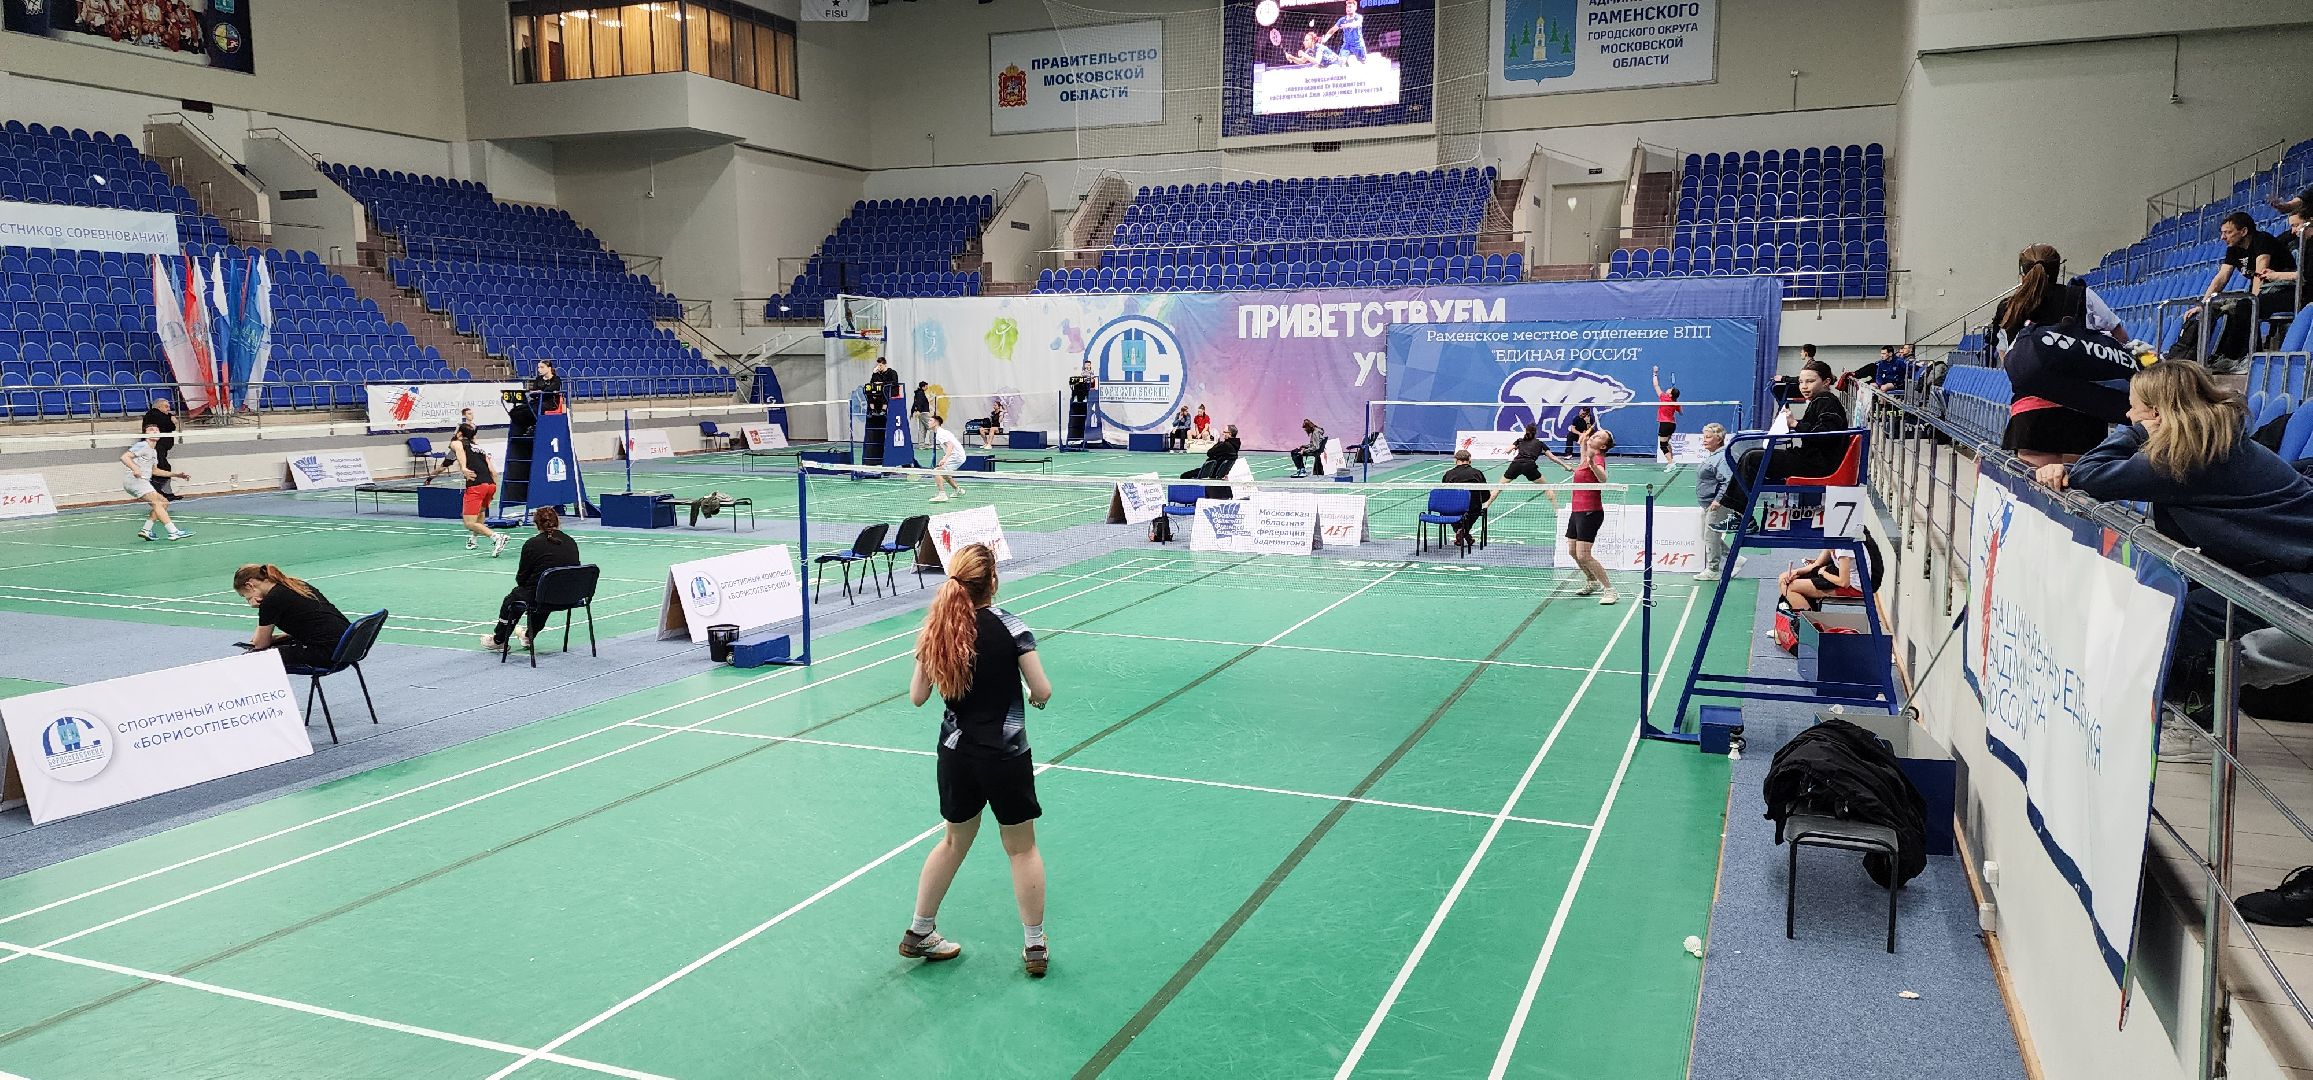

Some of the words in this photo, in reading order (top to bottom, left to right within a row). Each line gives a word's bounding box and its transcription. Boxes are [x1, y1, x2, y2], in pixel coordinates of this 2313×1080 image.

[825, 9, 848, 18] FISU
[1588, 2, 1700, 26] РАМЕНСКОГО
[1588, 26, 1655, 41] ГОРОДСКОГО
[1657, 22, 1699, 35] ОКРУГА
[1600, 36, 1684, 54] МОСКОВСКОЙ
[1031, 48, 1158, 71] ПРАВИТЕЛЬСТВО
[1612, 54, 1670, 69] ОБЛАСТИ
[1043, 65, 1145, 87] МОСКОВСКОЙ
[1059, 86, 1129, 102] ОБЛАСТИ
[66, 227, 169, 244] СОРЕВНОВАНИЙ!
[1426, 330, 1509, 343] Раменское
[1512, 330, 1579, 342] местное
[1582, 328, 1669, 341] отделение
[1673, 325, 1712, 339] ВПП
[2080, 339, 2141, 373] YONEX
[895, 415, 901, 427] 3
[550, 437, 560, 453] 1
[1258, 508, 1310, 518] Московская
[1767, 510, 1789, 528] 21
[1832, 501, 1858, 537] 7
[1323, 525, 1354, 538] ЛЕТ
[1657, 552, 1696, 567] ЛЕТ
[117, 702, 215, 734] СПОРТИВНЫЙ
[217, 688, 287, 713] КОМПЛЕКС
[132, 706, 285, 751] «БОРИСОГЛЕБСКИЙ»
